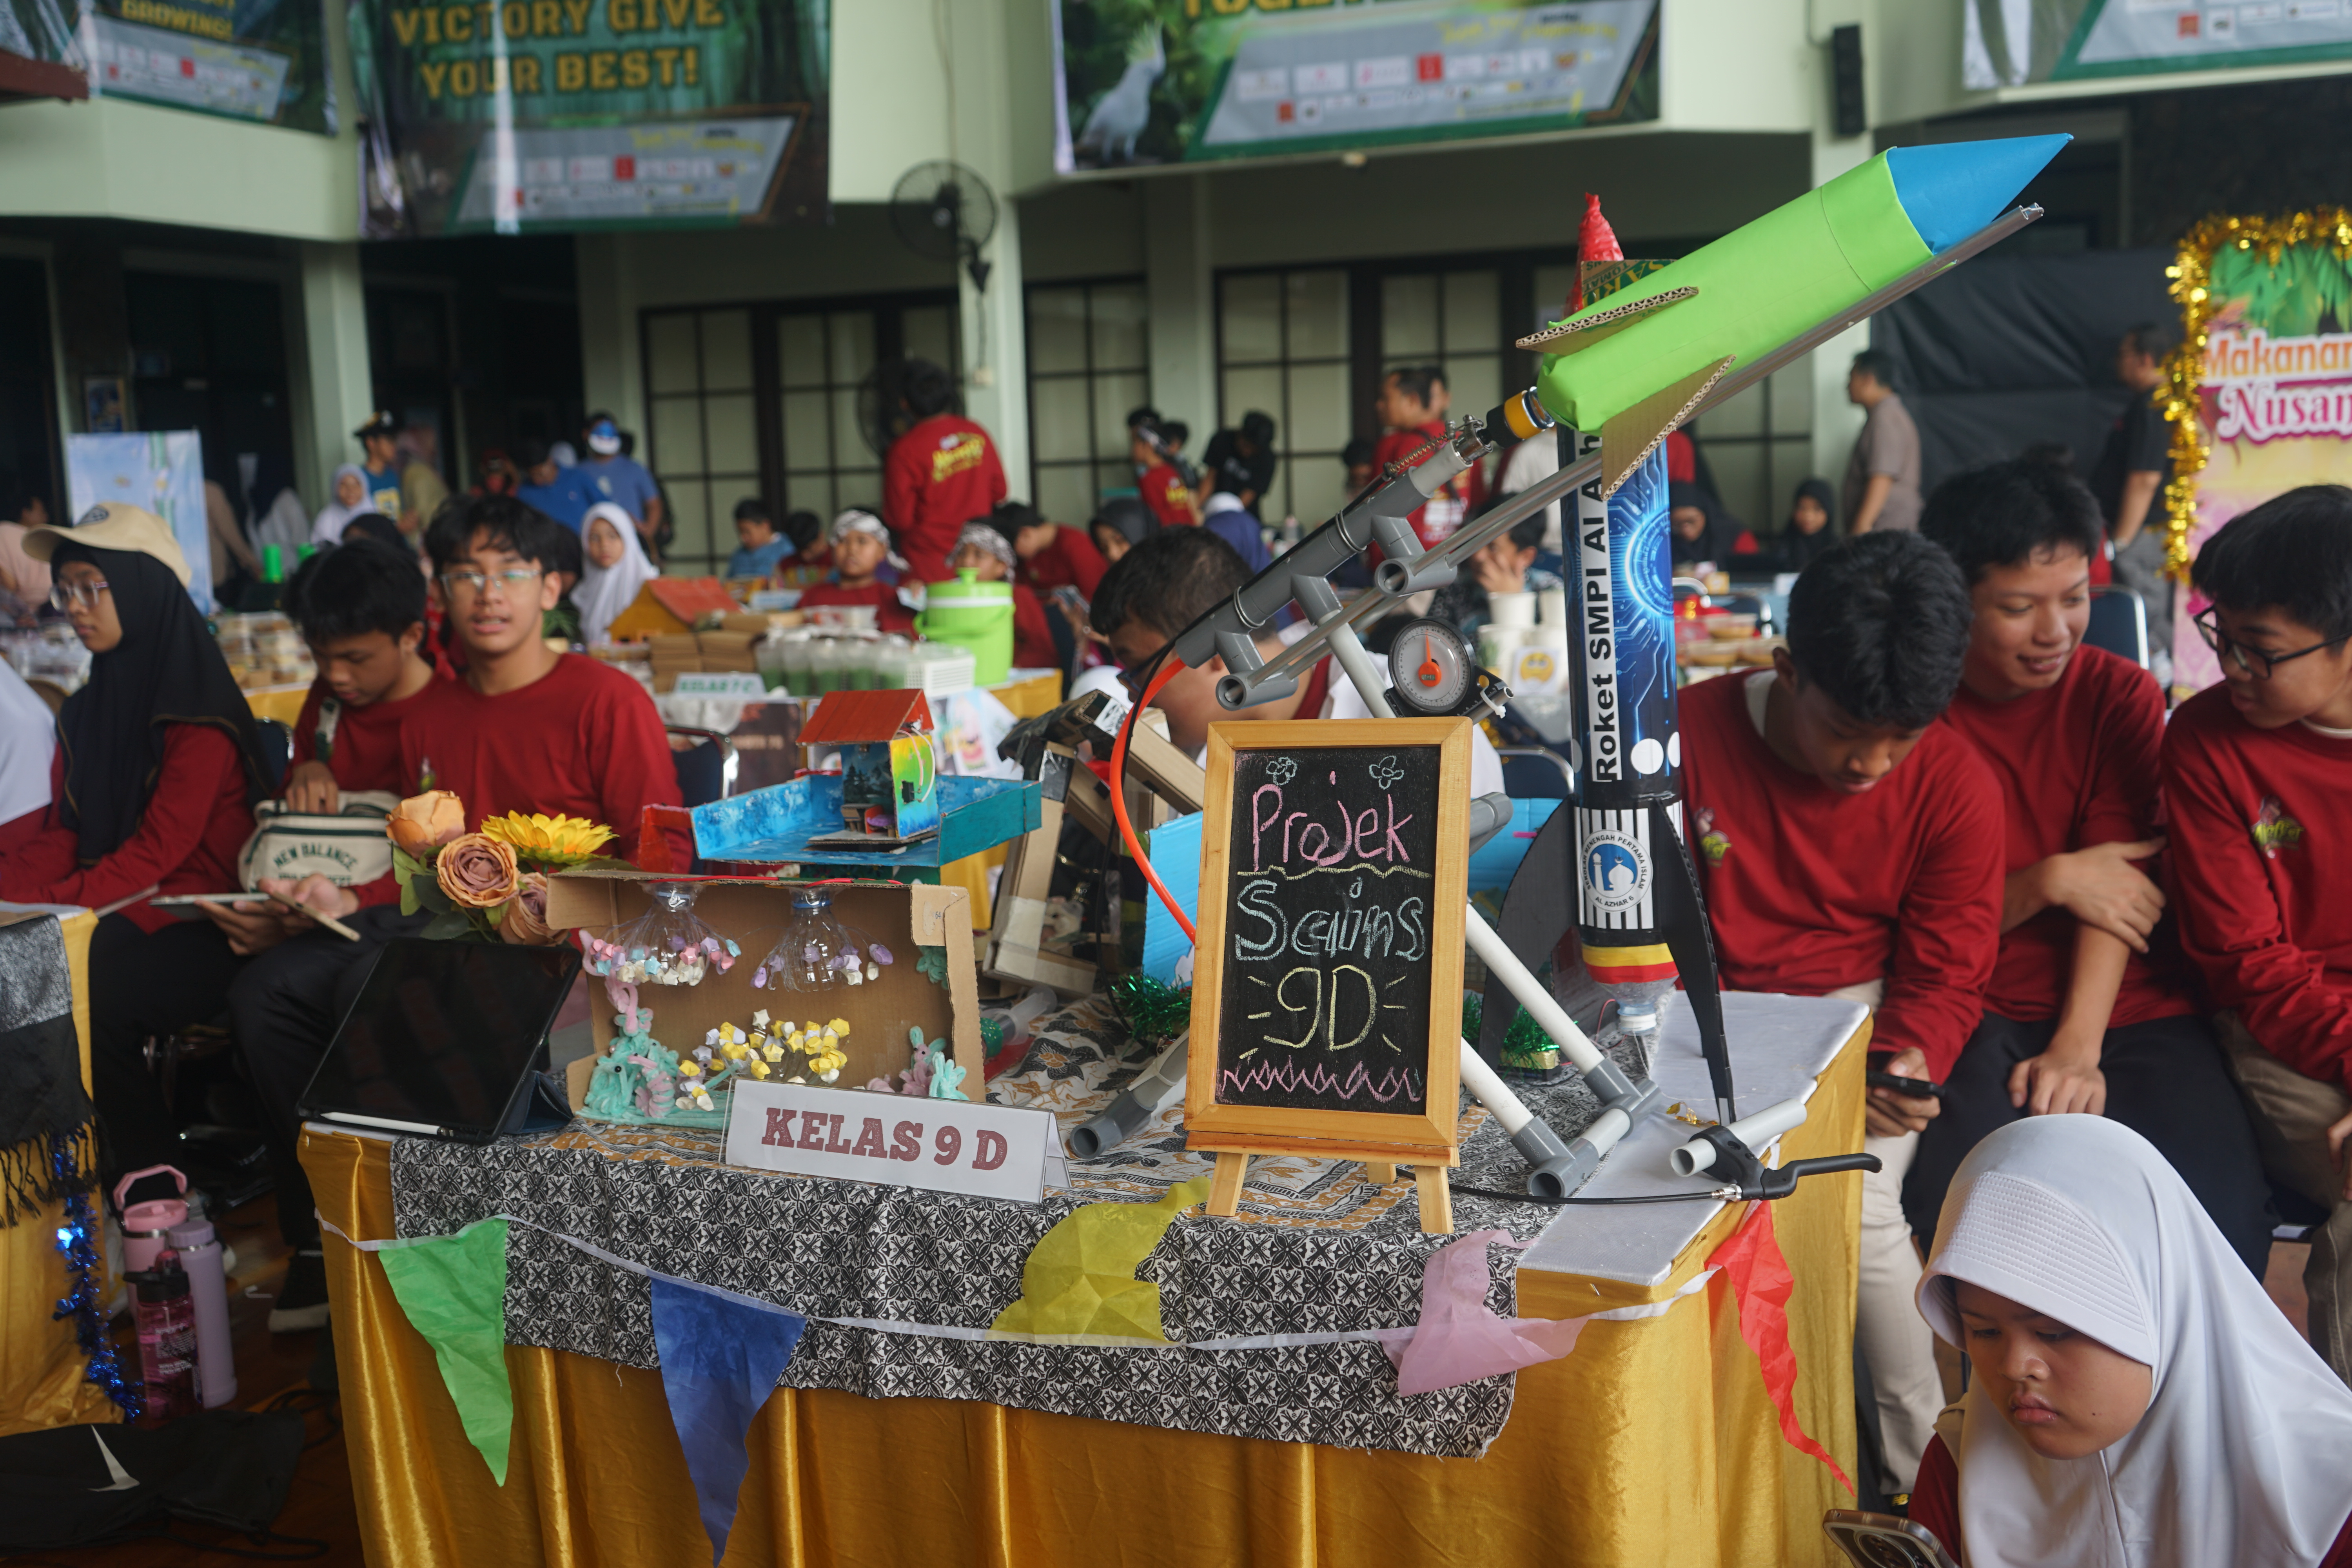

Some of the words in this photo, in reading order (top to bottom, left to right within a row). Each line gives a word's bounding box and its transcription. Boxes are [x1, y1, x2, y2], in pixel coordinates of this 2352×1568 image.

[392, 0, 590, 46] VICTORY
[608, 0, 724, 32] GIVE
[420, 56, 540, 99] YOUR
[557, 46, 698, 92] BEST!
[1586, 568, 1612, 660] SMPI
[1592, 673, 1617, 781] Roket
[273, 844, 298, 869] NEW
[301, 842, 357, 871] BALANCE
[1584, 835, 1615, 854] MENENGAH
[1618, 837, 1645, 864] PERTAMA
[1638, 866, 1648, 889] ISLAM
[1595, 896, 1603, 905] AL
[1604, 899, 1628, 907] AZHAR
[1263, 964, 1377, 1052] 9D
[761, 1107, 924, 1162] KELAS
[933, 1125, 962, 1166] 9
[972, 1129, 1008, 1171] D
